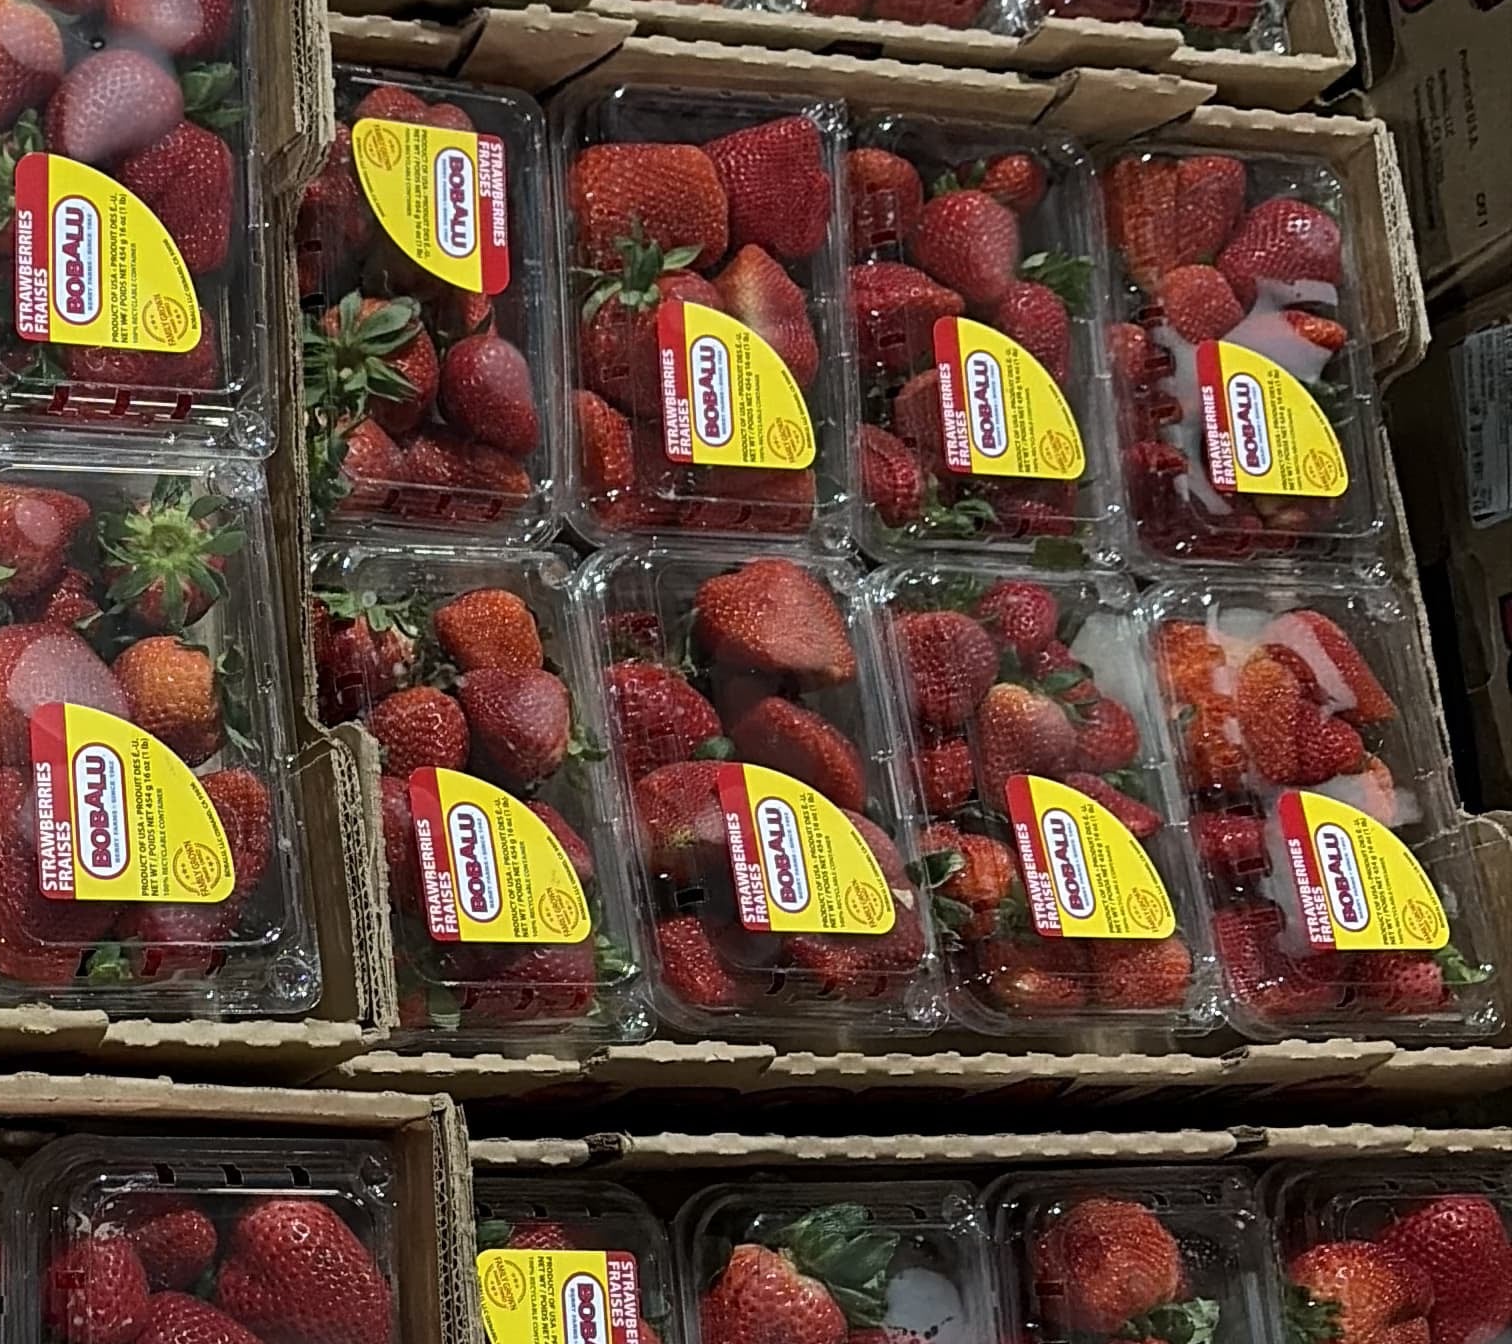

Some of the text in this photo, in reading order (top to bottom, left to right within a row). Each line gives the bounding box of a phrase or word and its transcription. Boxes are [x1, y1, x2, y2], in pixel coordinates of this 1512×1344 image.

[448, 155, 468, 248] BOBALU
[18, 209, 33, 332] STRAWBERRIES
[34, 267, 47, 333] FRAISES
[62, 206, 84, 314] BOBALU
[699, 345, 719, 437] BOBALU
[973, 359, 996, 448] BOBALU
[1235, 381, 1260, 467] BOBALU
[36, 761, 57, 890] STRAWBERRIES
[55, 820, 73, 890] FRAISES
[84, 755, 111, 867] BOBALU
[765, 807, 797, 903] BOBALU
[417, 818, 445, 932] STRAWBERRIES
[438, 871, 458, 933] FRAISES
[457, 813, 488, 912] BOBALU
[726, 811, 756, 922] STRAWBERRIES
[748, 863, 768, 923] FRAISES
[1049, 818, 1084, 909] BOBALU
[1322, 832, 1358, 922] BOBALU
[608, 1260, 623, 1327] FRAISES
